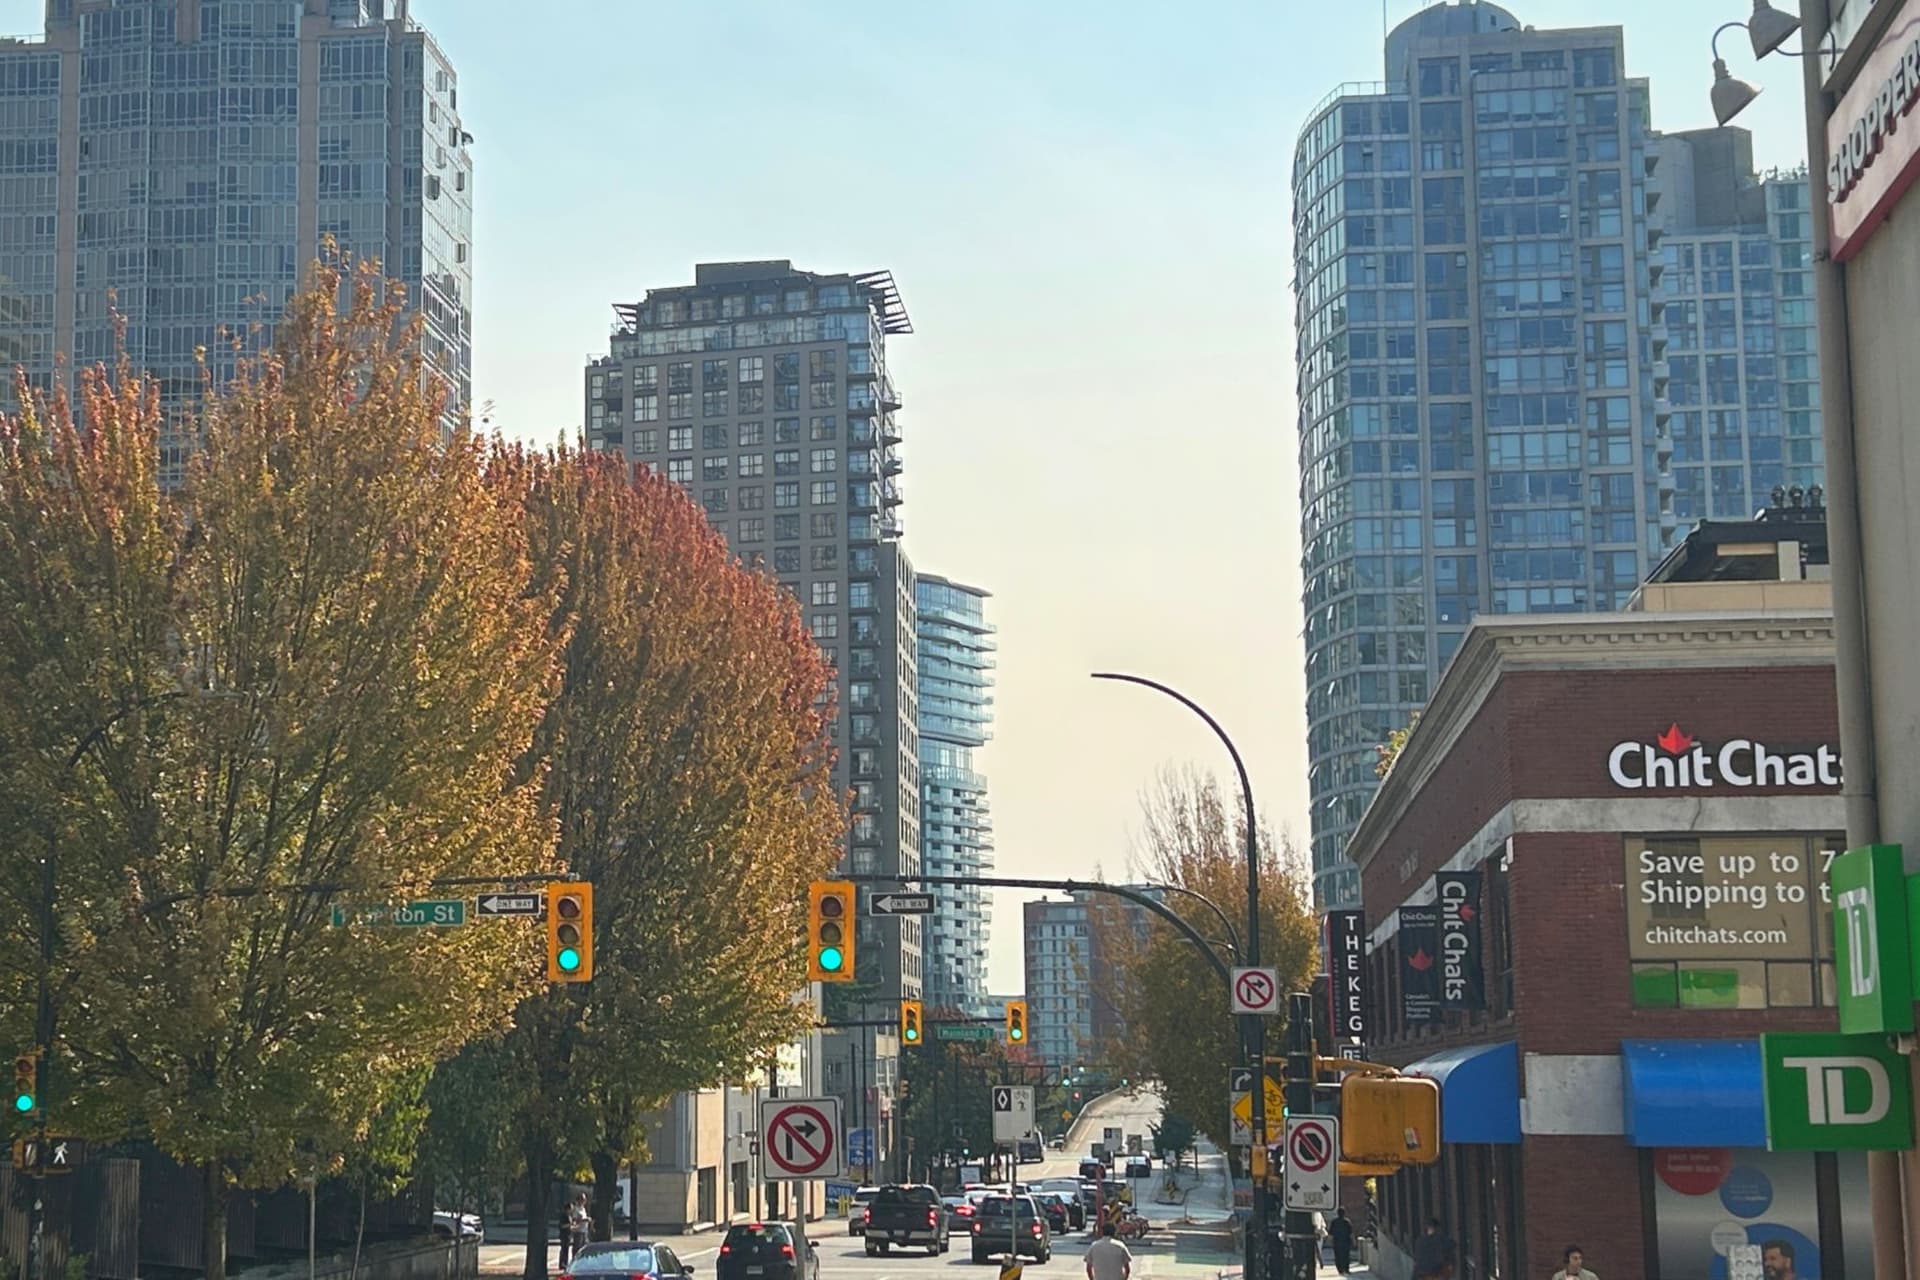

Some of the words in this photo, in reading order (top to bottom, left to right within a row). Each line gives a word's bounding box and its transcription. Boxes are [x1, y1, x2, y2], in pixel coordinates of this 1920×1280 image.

[1826, 37, 1920, 205] SHOPPER
[1608, 741, 1713, 788] Chit
[1639, 850, 1705, 874] Save
[1719, 854, 1756, 879] up
[1769, 851, 1800, 873] to
[515, 900, 532, 908] WAY
[910, 900, 927, 908] WAY
[1442, 880, 1467, 930] Chit
[1640, 879, 1768, 909] Shipping
[1775, 881, 1805, 903] to
[433, 904, 456, 922] St
[1645, 925, 1787, 944] chitchats.com
[1443, 932, 1469, 1001] Chats
[1782, 1056, 1891, 1125] TD
